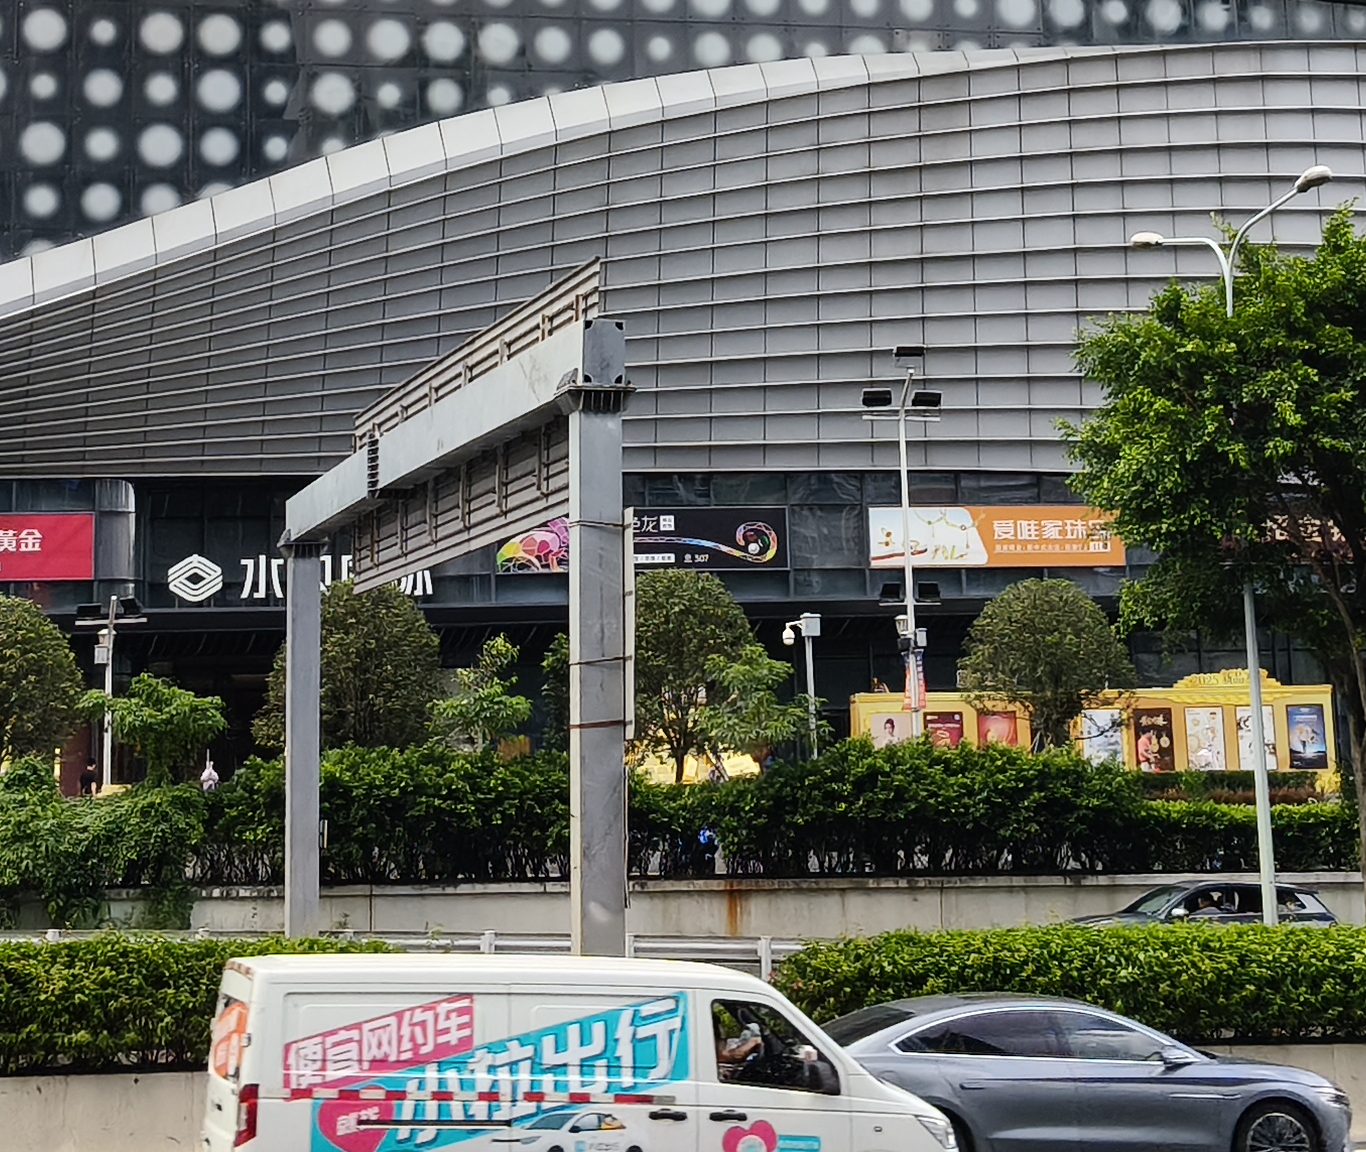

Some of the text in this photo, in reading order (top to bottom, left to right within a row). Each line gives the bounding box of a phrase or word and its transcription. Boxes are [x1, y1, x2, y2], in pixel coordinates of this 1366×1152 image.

[287, 998, 472, 1089] 便宜网约车
[396, 998, 682, 1146] 小拉出行
